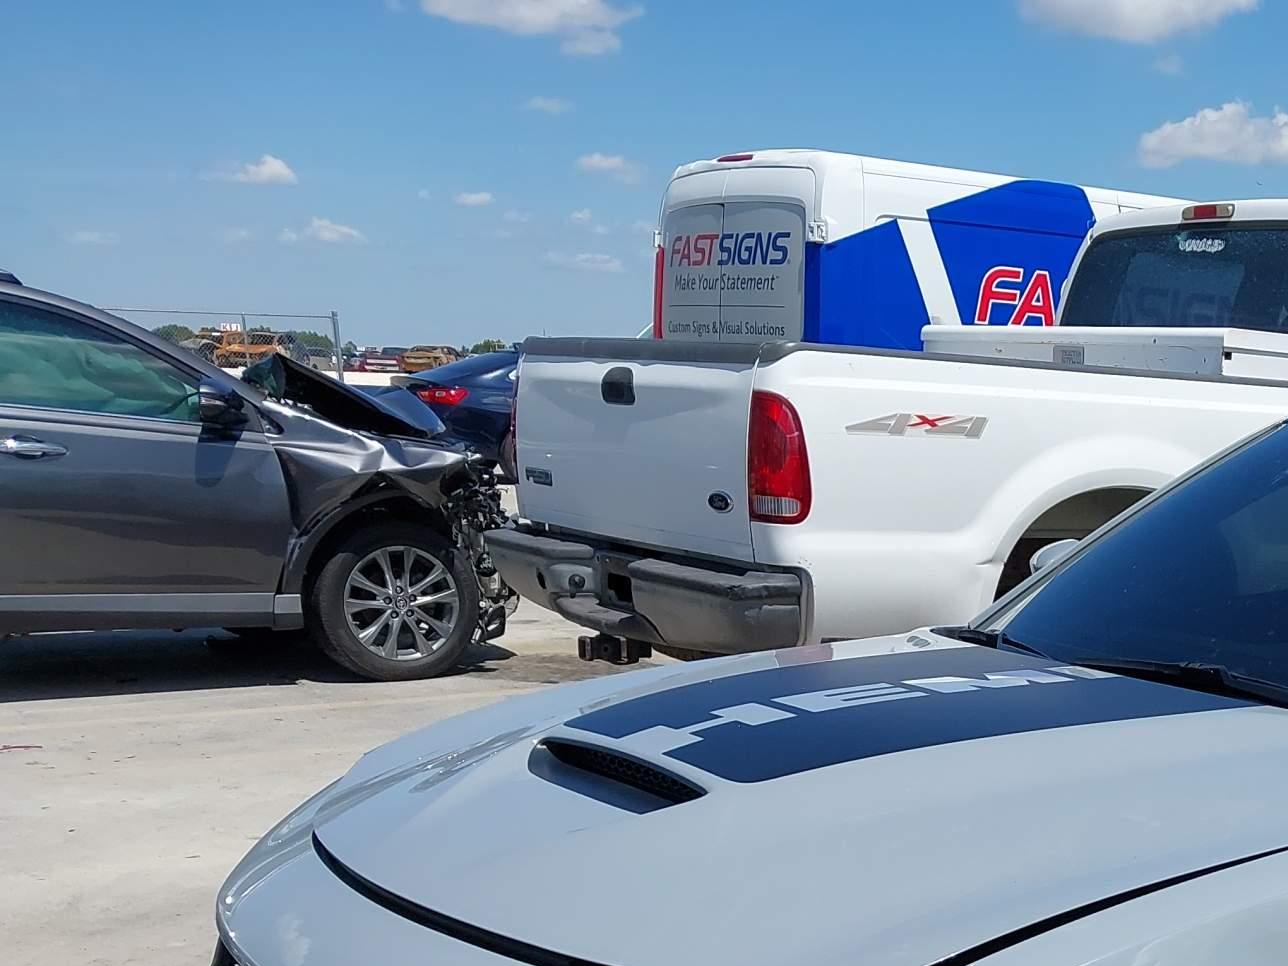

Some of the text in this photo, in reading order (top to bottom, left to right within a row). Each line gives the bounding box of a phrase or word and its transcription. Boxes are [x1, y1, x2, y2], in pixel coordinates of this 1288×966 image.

[675, 273, 776, 291] Make Your Statement
[668, 320, 785, 337] Custom Signs & Visual Solutions
